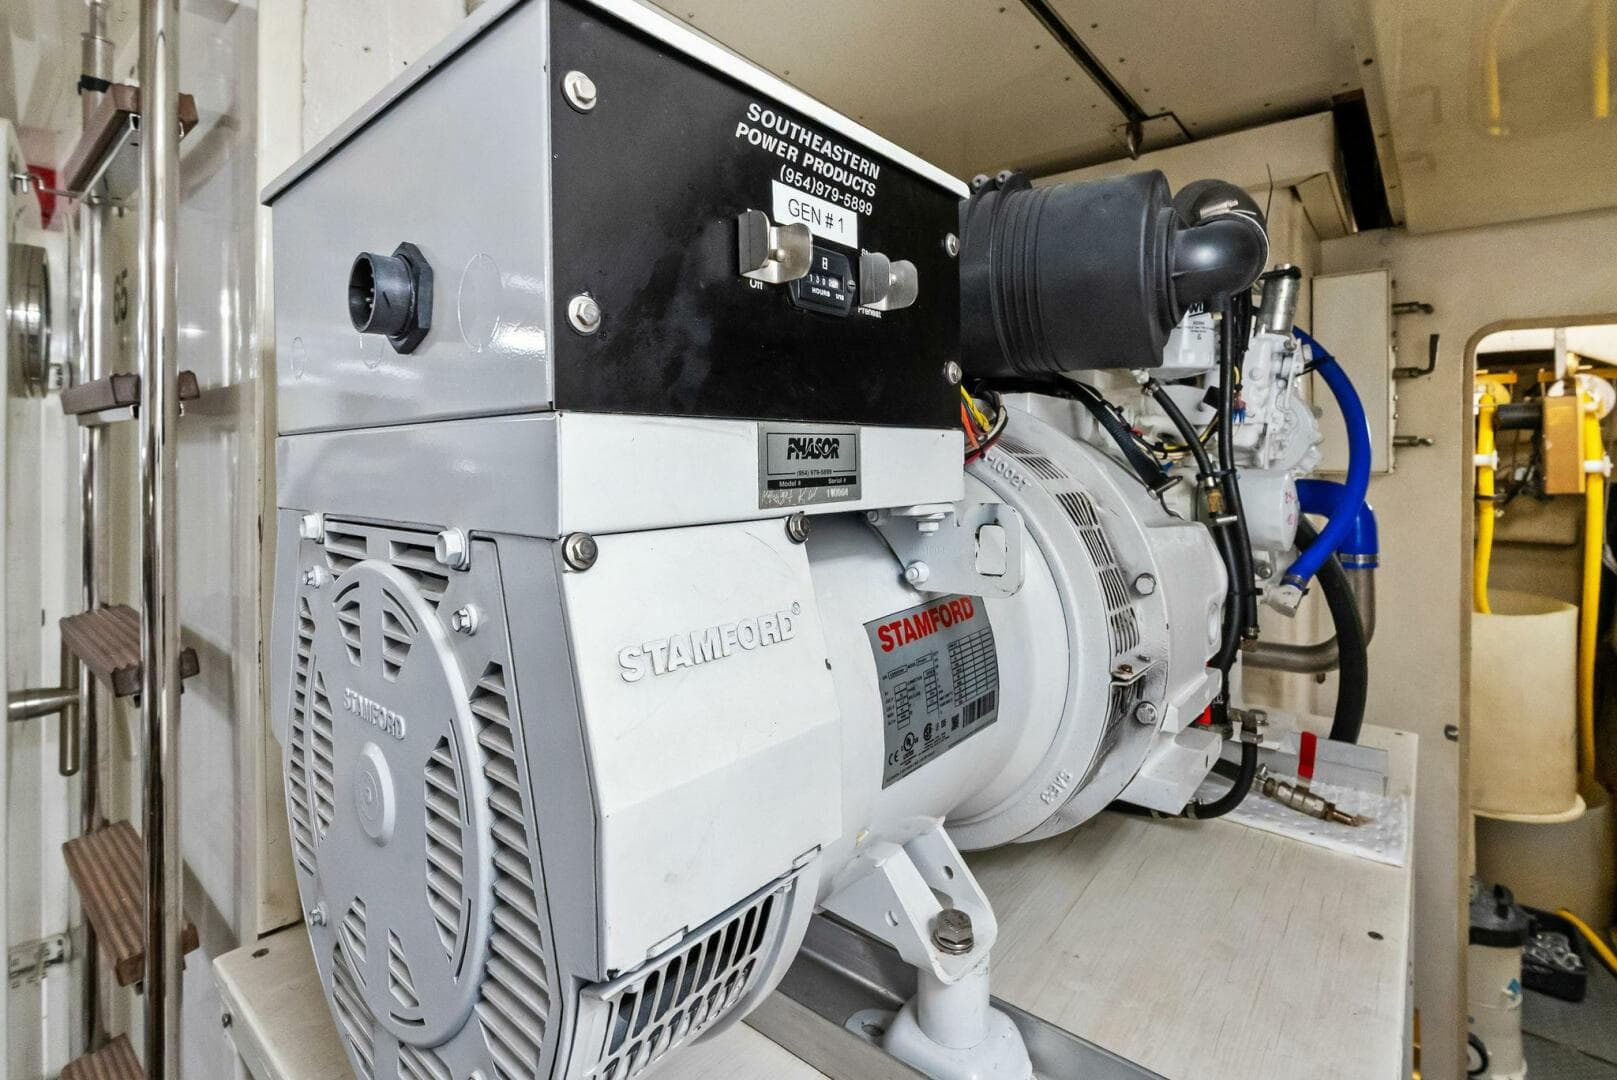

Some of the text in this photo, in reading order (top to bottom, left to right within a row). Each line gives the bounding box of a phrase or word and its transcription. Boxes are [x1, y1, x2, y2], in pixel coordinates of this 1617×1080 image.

[736, 122, 876, 197] POWER PRODUCTS
[747, 103, 880, 180] SOUTHEASTERN
[780, 164, 873, 216] (954)979-5899
[788, 199, 845, 233] GEN # 1
[787, 437, 840, 460] PHASOR
[877, 595, 975, 653] STAMFORD
[343, 687, 406, 741] STAMFORD
